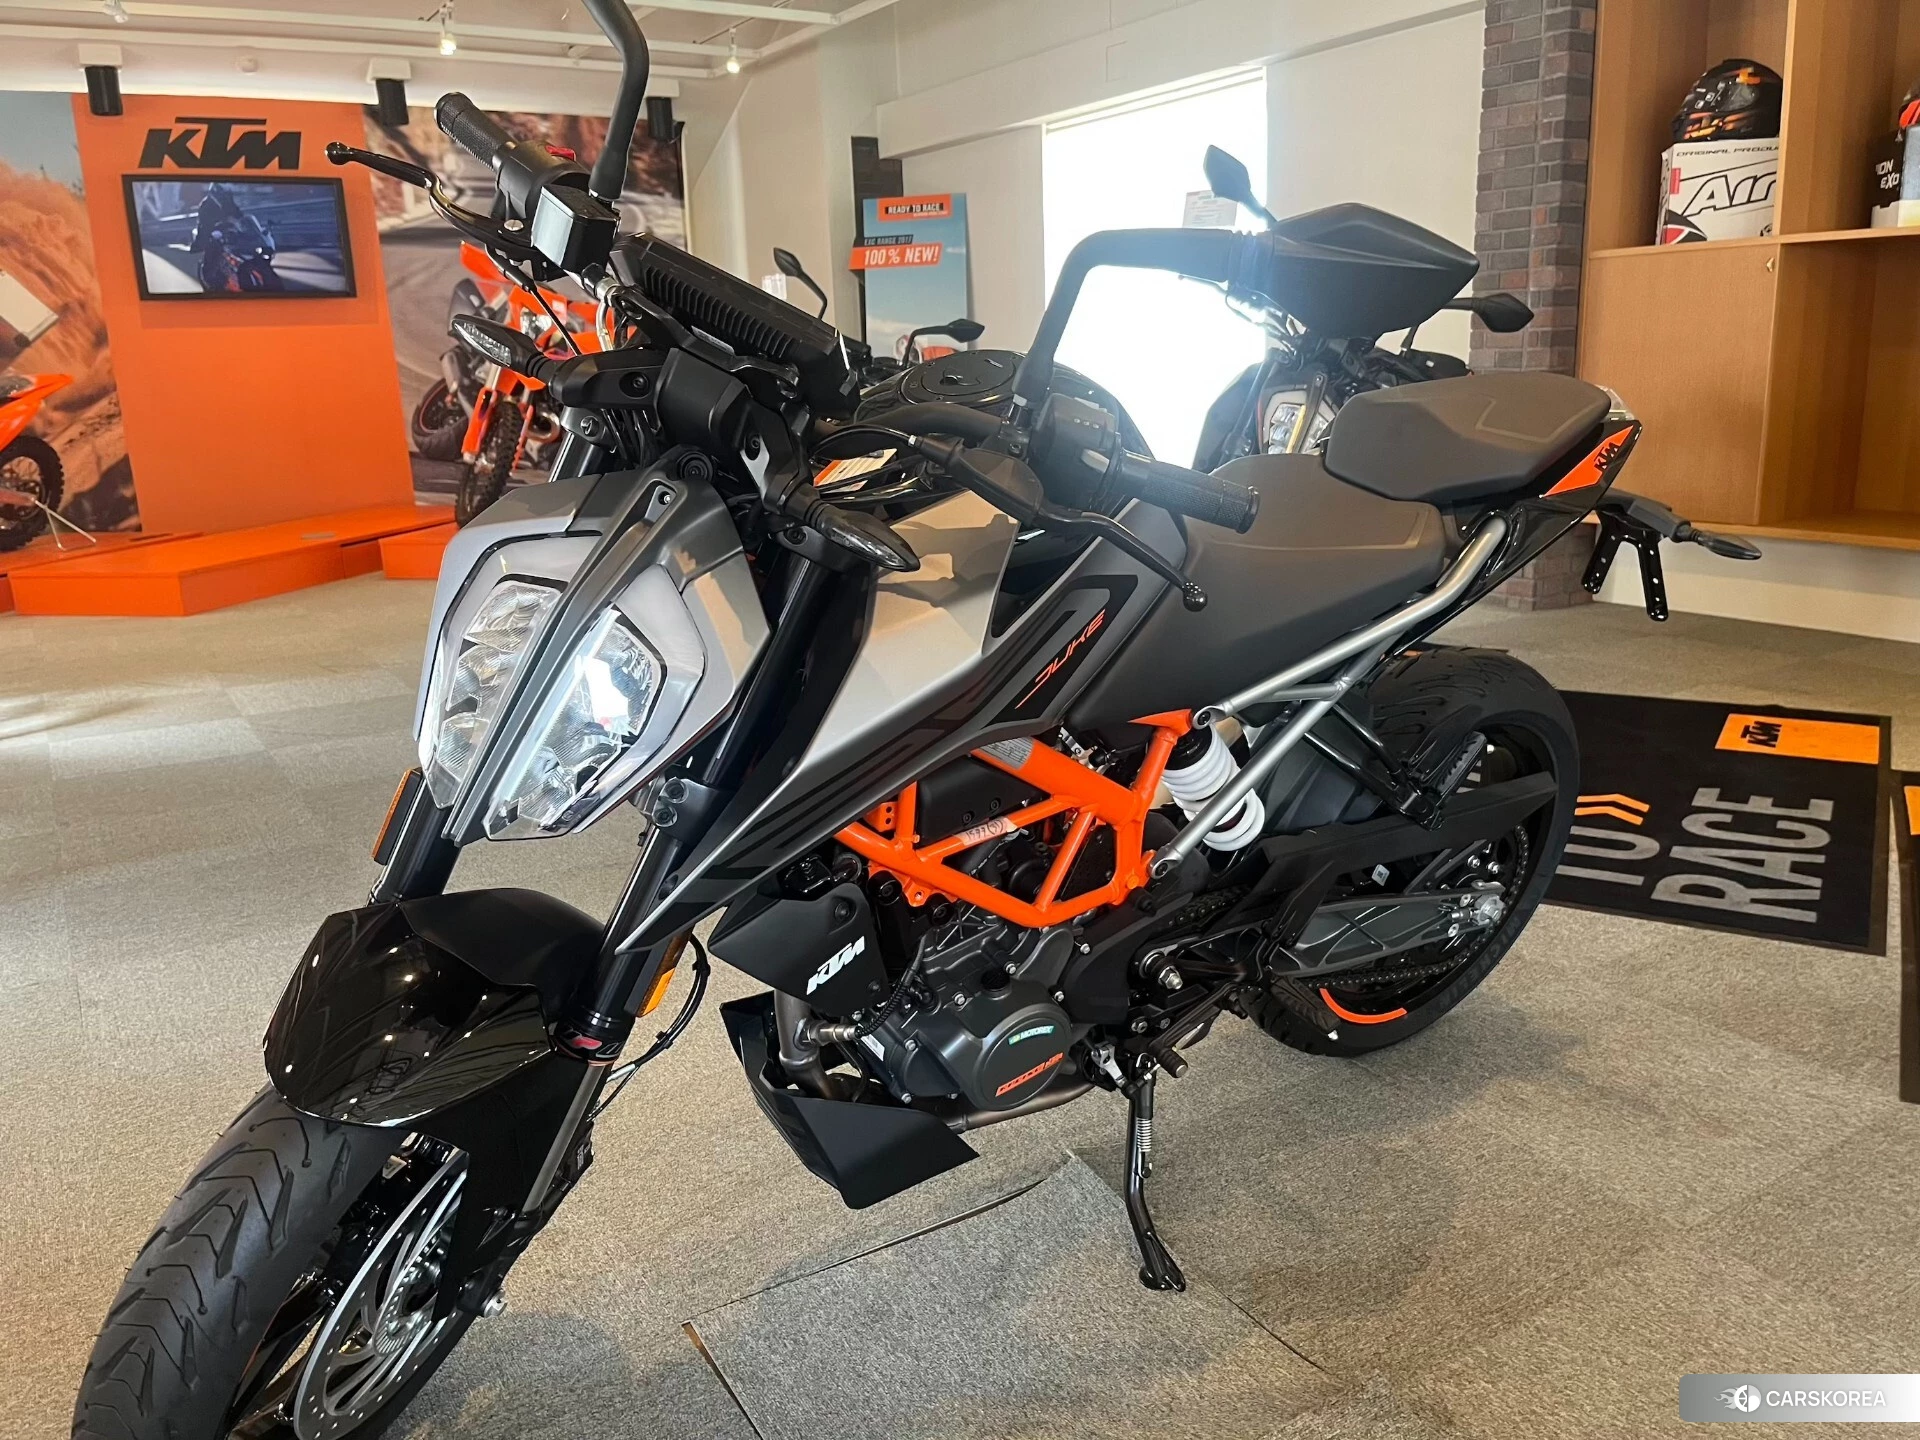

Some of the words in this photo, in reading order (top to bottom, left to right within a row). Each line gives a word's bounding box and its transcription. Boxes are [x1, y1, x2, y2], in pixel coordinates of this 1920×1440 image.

[138, 117, 302, 170] KTM
[1676, 147, 1731, 157] ORIGINAL
[1880, 172, 1900, 189] EXO
[888, 205, 911, 214] READY
[912, 204, 921, 213] TO
[922, 203, 940, 212] RACE
[864, 248, 901, 266] 100%
[904, 245, 939, 263] NEW!
[1593, 441, 1621, 473] KTM
[1740, 720, 1782, 748] KTM
[1650, 787, 1835, 924] RACE
[806, 935, 866, 996] KTM
[1019, 1025, 1055, 1040] MOTOREX
